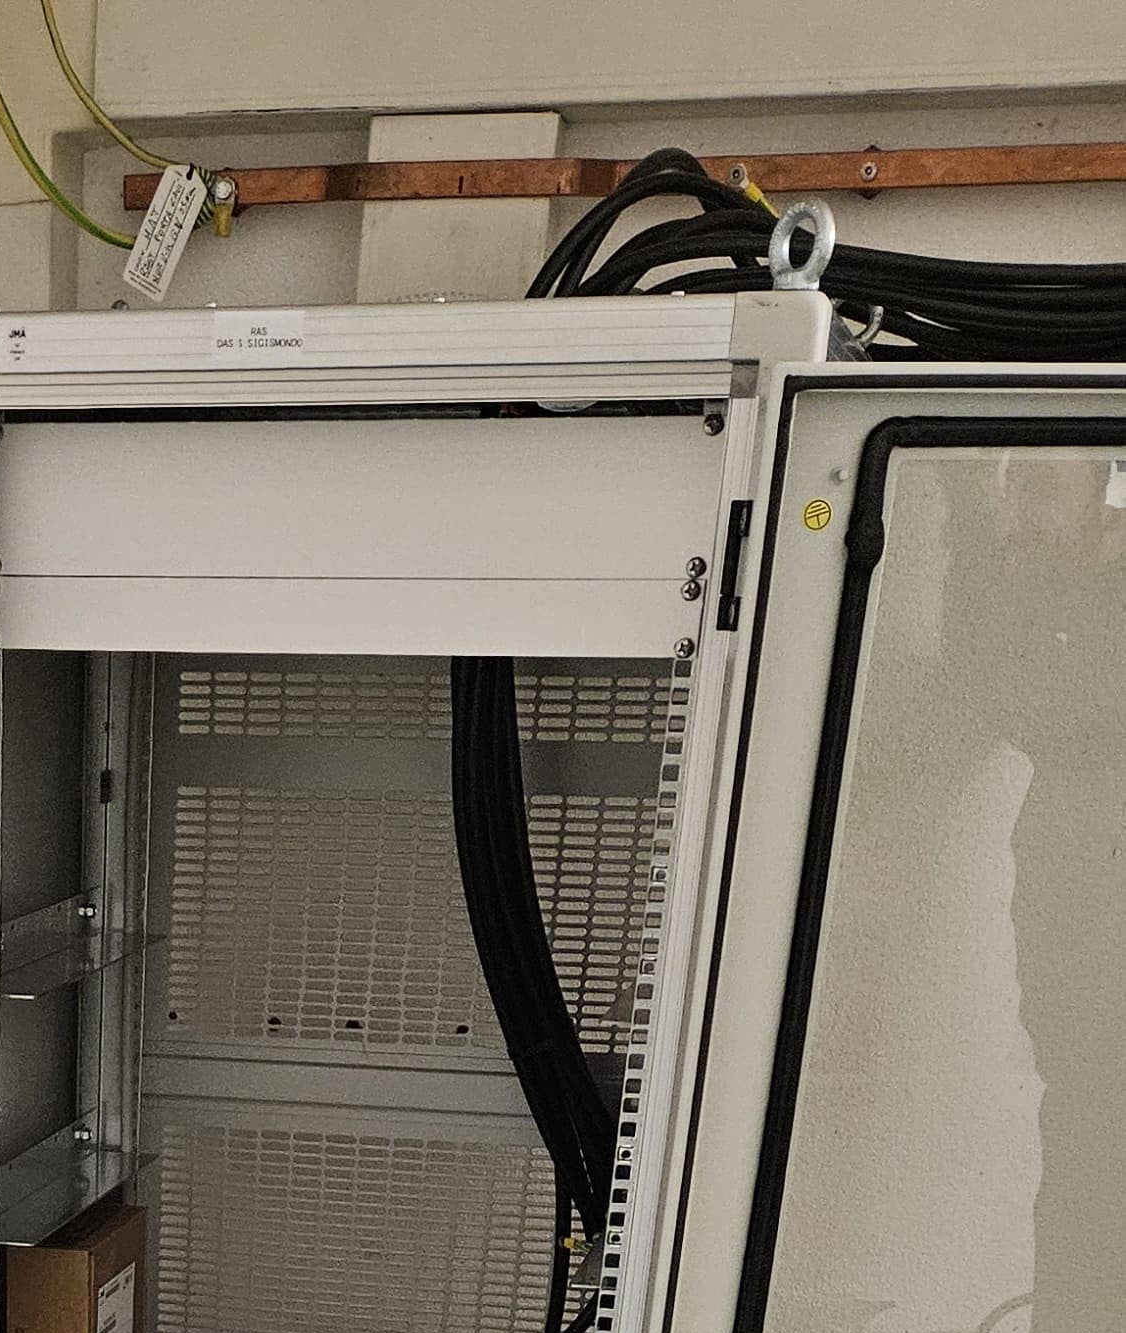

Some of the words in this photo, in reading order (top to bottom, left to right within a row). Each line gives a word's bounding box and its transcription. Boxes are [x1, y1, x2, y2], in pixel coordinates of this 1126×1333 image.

[10, 330, 26, 338] JMA
[250, 327, 268, 336] RAS
[216, 339, 234, 348] DAS
